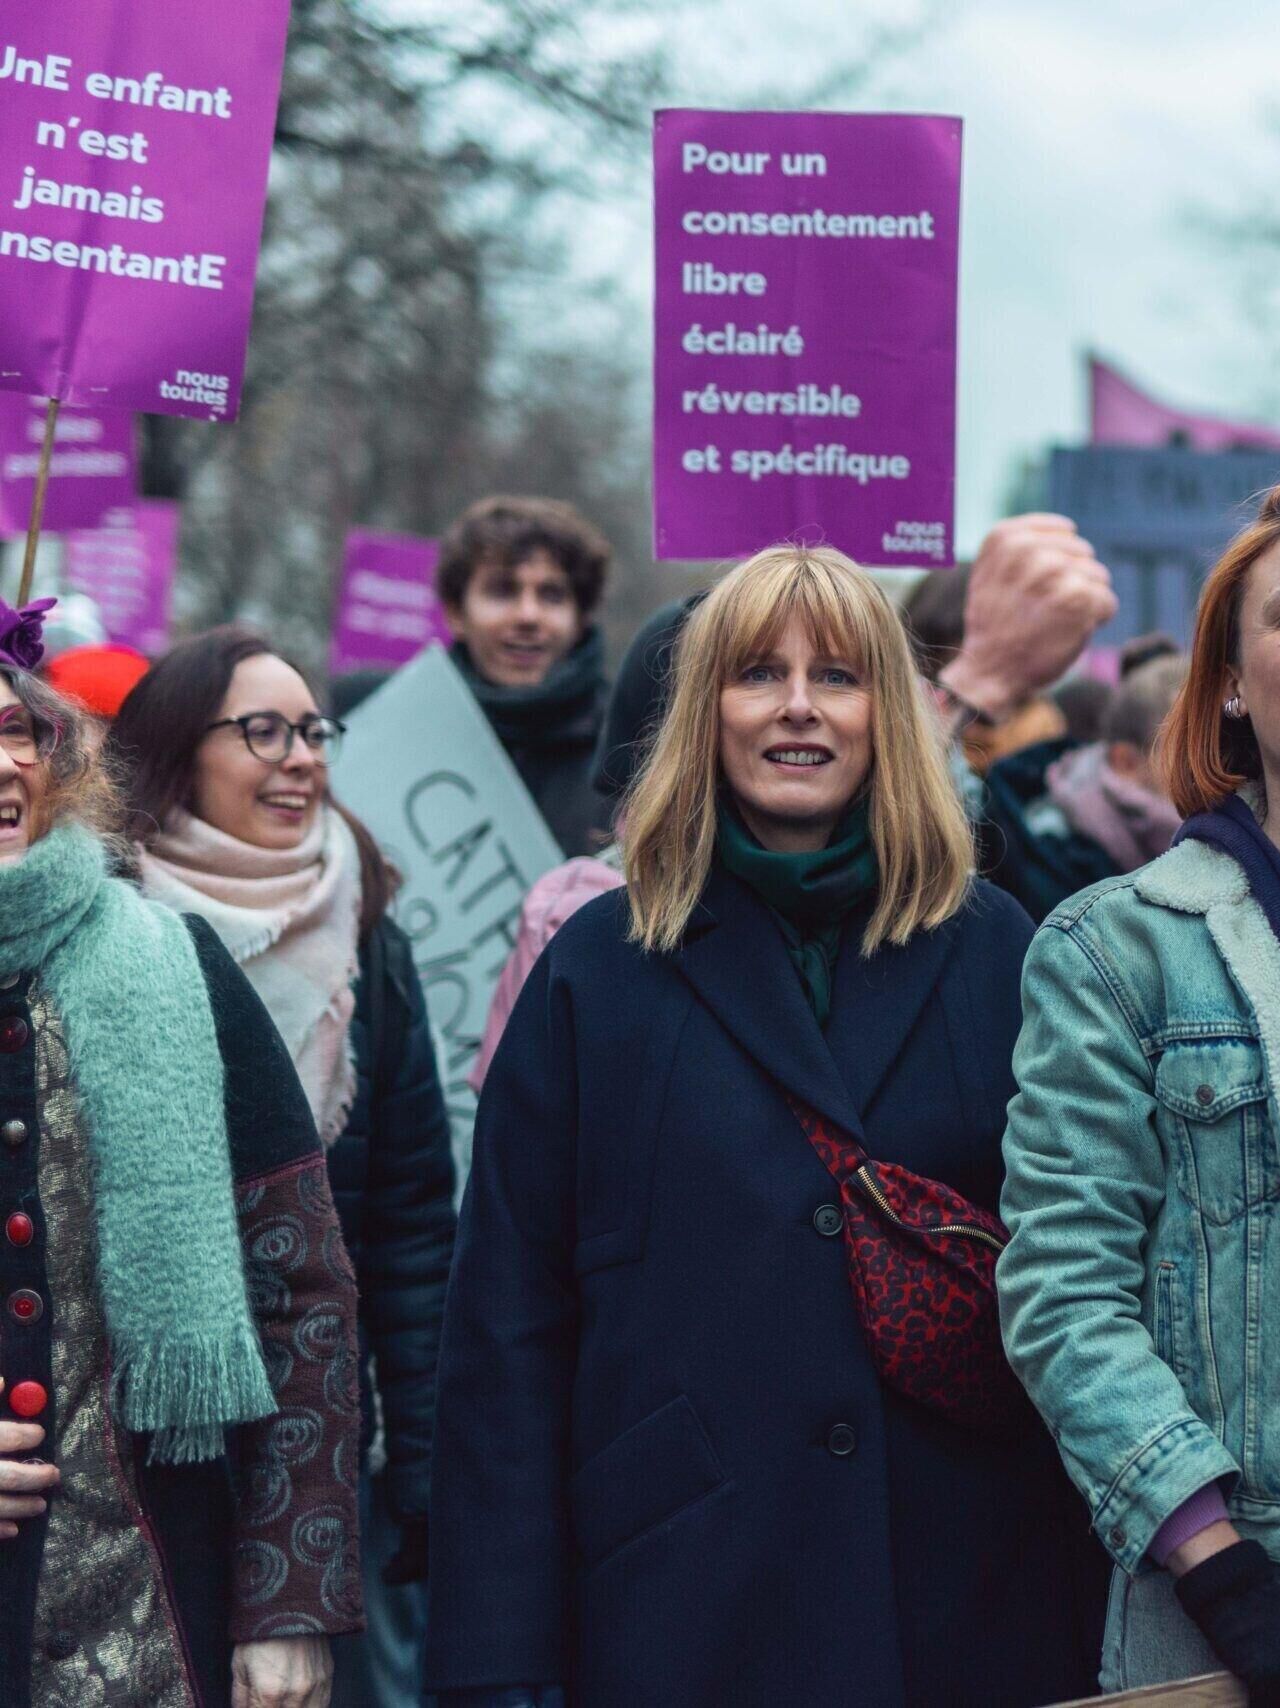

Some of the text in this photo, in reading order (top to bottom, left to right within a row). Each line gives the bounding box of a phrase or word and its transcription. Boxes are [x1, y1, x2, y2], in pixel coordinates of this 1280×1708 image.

[86, 72, 231, 118] enfant
[37, 117, 148, 163] n'est
[683, 143, 826, 175] Pour un
[14, 167, 163, 222] jamais
[683, 209, 934, 239] consentement
[683, 262, 766, 295] libre
[683, 323, 804, 355] éclairé
[160, 380, 228, 405] toutes
[176, 370, 228, 390] nous
[683, 384, 860, 417] réversible
[683, 444, 910, 484] et spécifique
